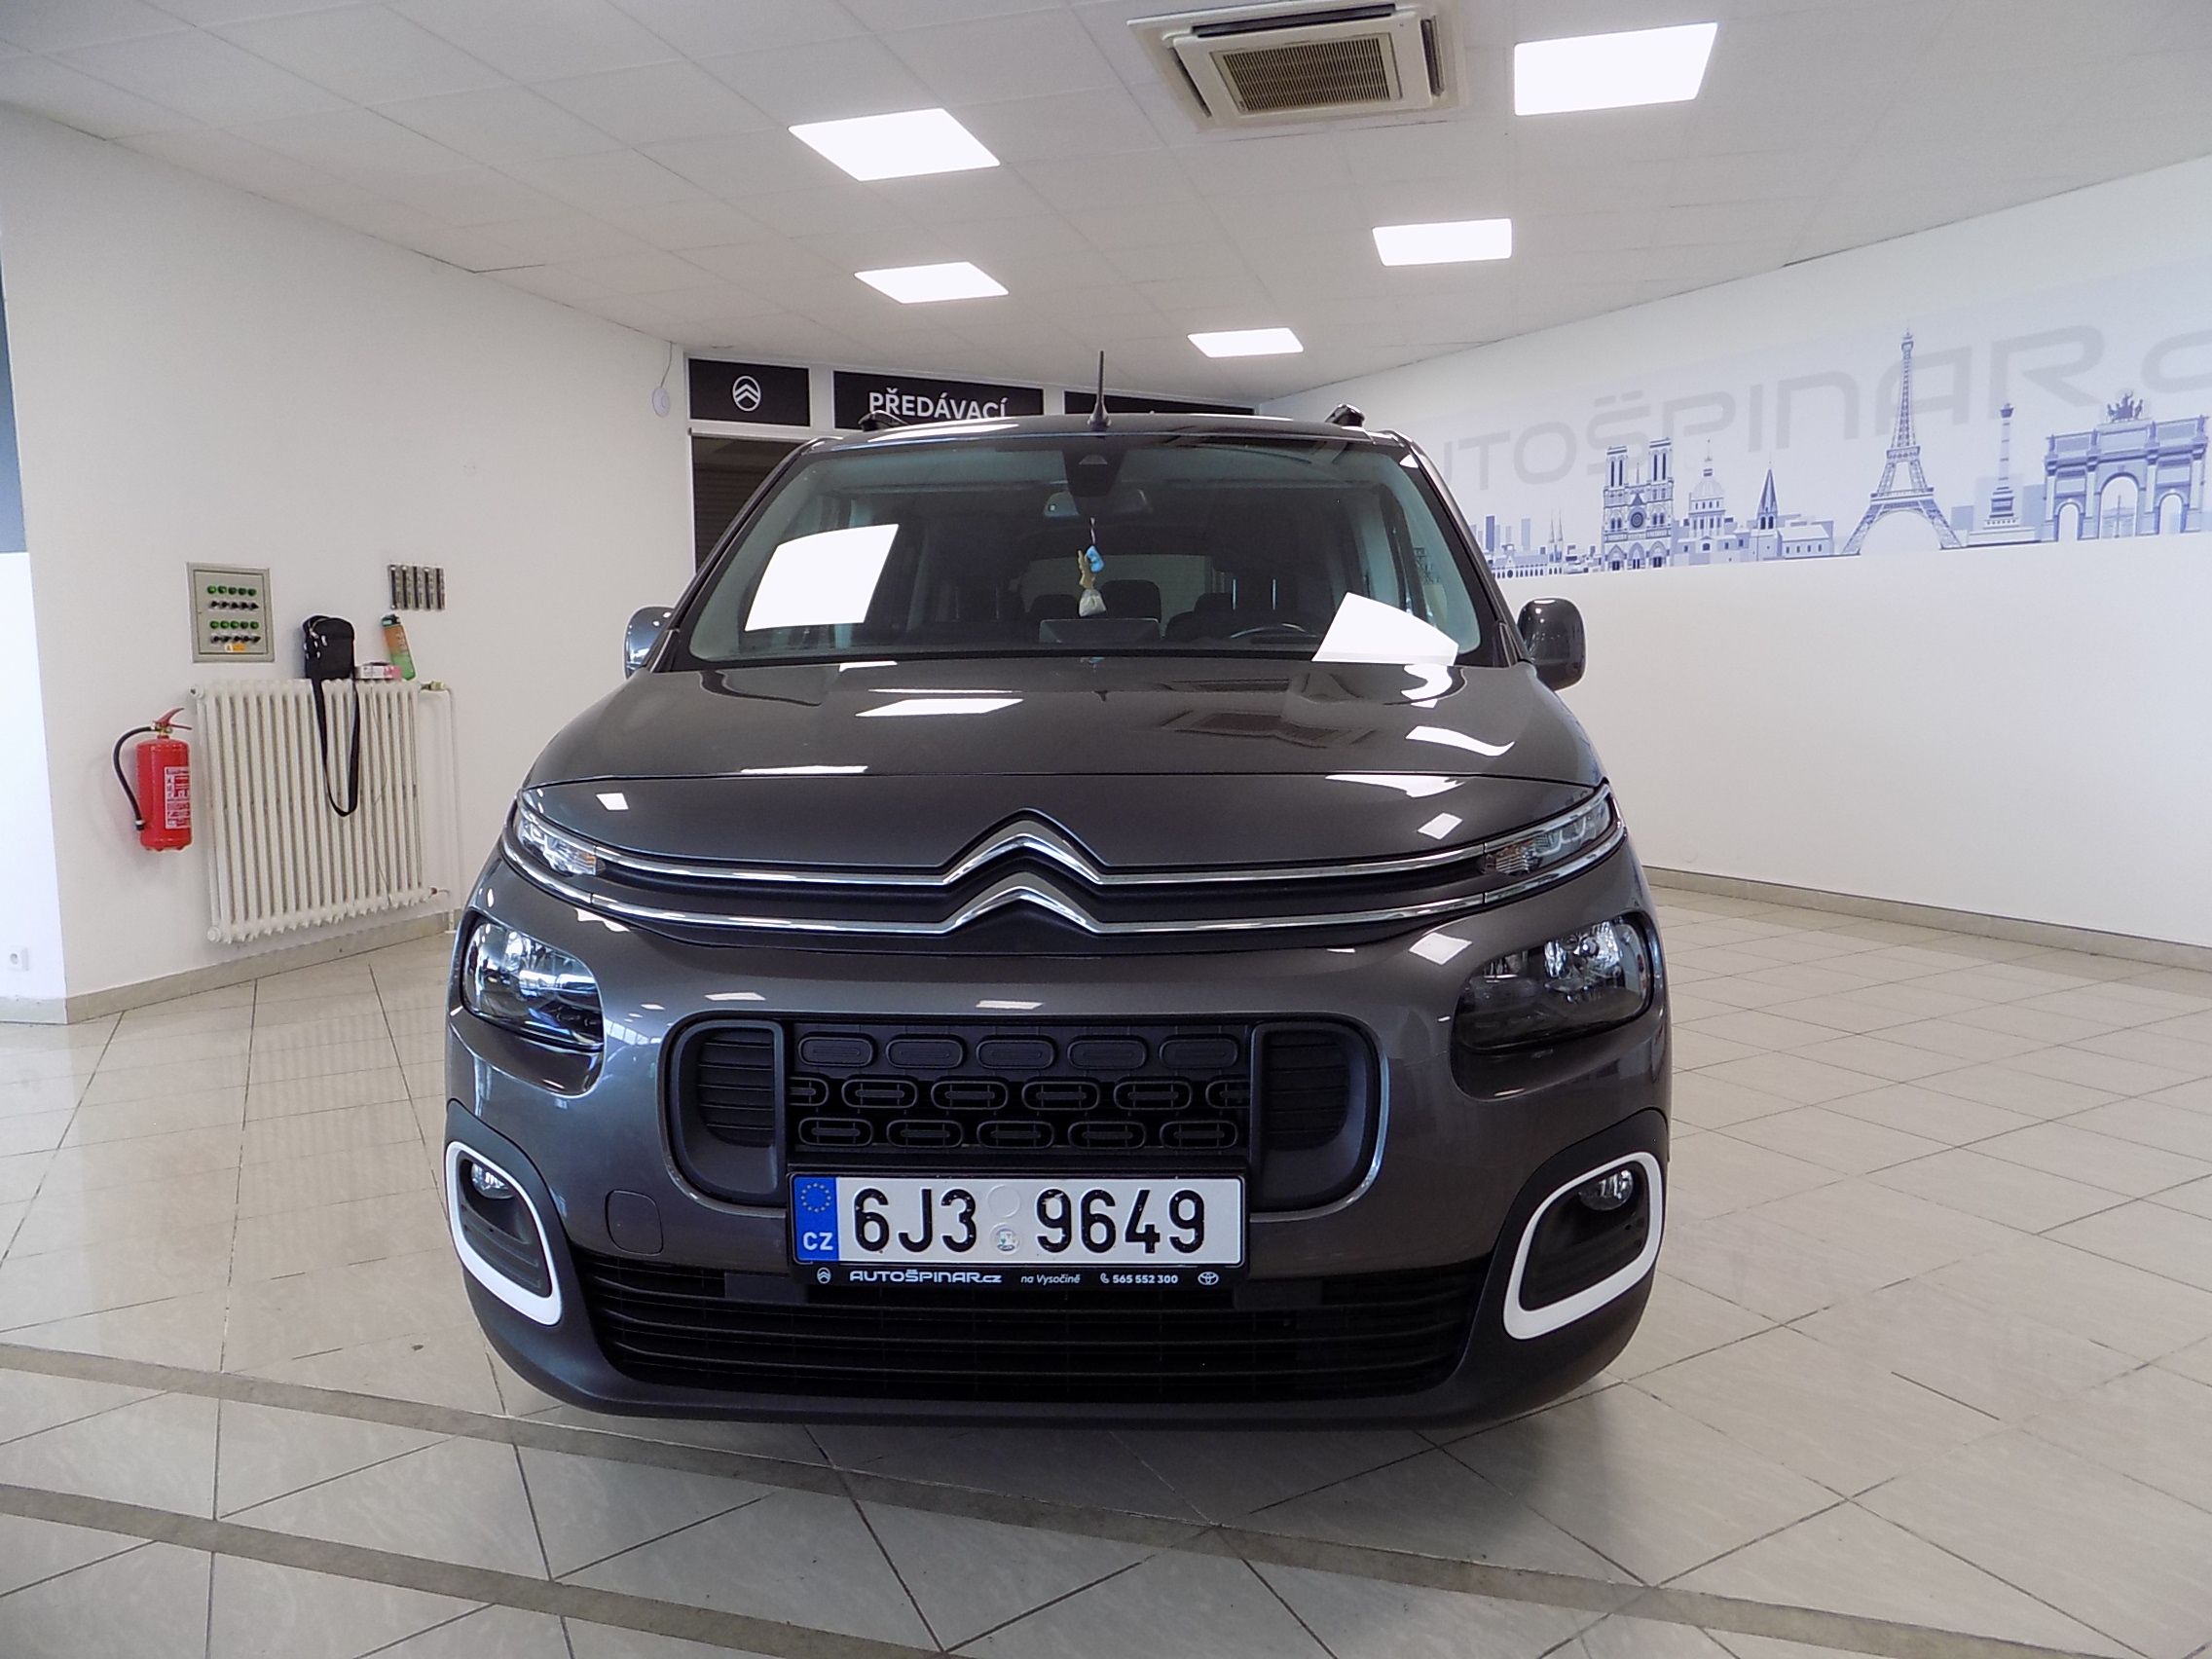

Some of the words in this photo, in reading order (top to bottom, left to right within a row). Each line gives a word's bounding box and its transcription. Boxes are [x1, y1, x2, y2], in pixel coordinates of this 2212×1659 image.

[868, 387, 1009, 420] PŘEDÁVACÍ
[853, 1188, 977, 1253] 6J3
[1036, 1189, 1206, 1254] 9649
[801, 1231, 834, 1251] CZ
[1020, 1274, 1034, 1284] na
[1036, 1272, 1081, 1286] Vysočině
[1112, 1273, 1133, 1284] 565
[1135, 1273, 1156, 1284] 552
[1157, 1273, 1179, 1284] 300
